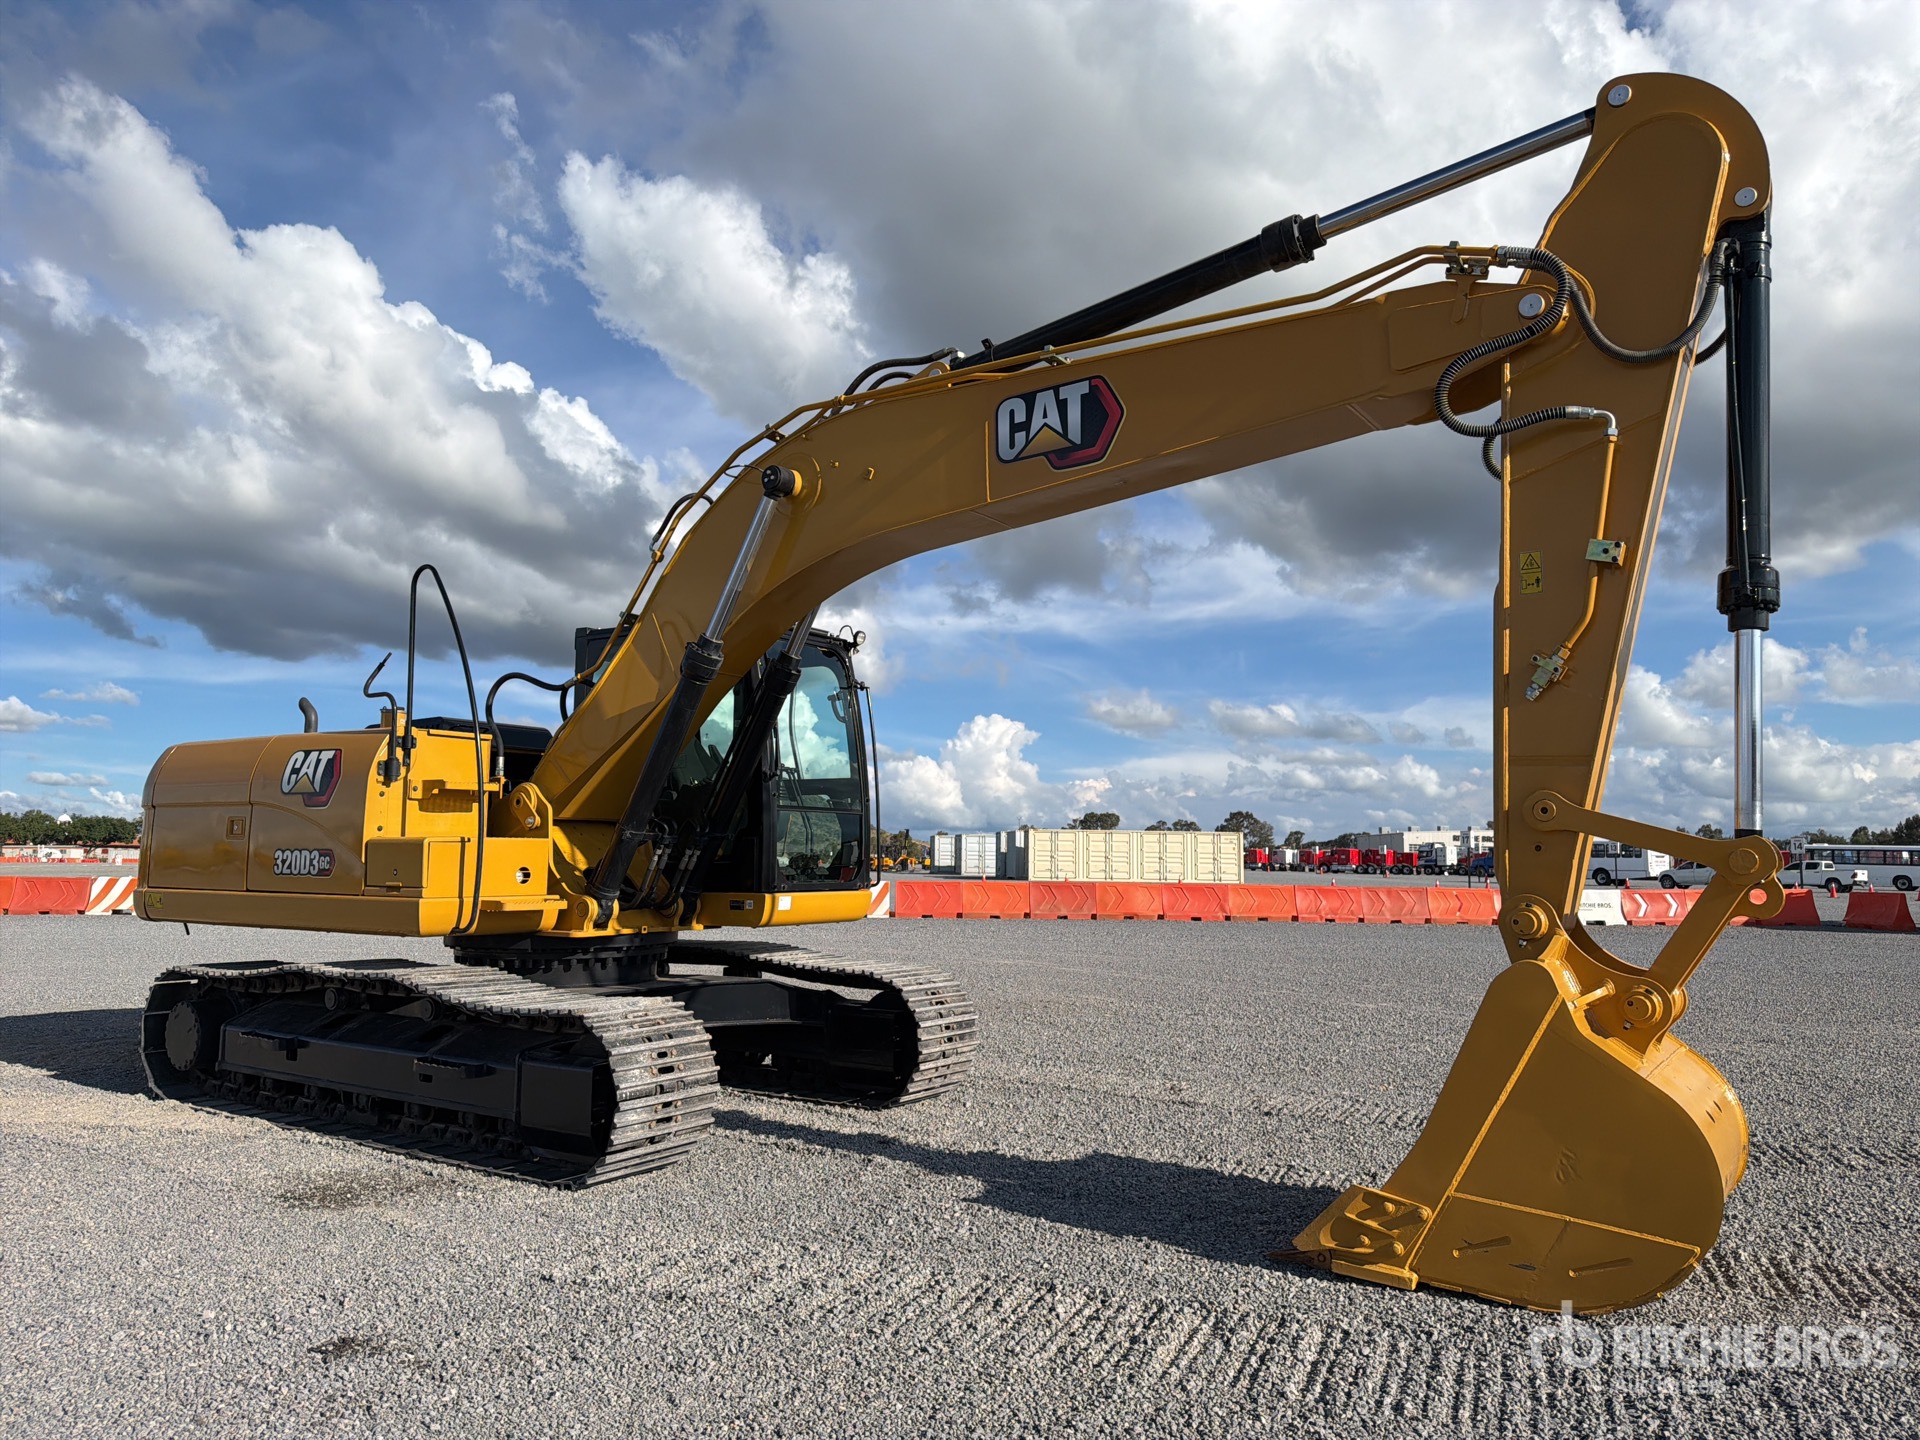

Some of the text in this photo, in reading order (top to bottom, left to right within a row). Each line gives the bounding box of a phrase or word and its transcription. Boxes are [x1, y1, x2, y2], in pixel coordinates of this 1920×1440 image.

[998, 380, 1090, 461] CAT
[281, 750, 336, 794] CAT
[1461, 835, 1470, 844] 17
[1793, 842, 1803, 850] 14
[273, 849, 330, 875] 320D3 GC
